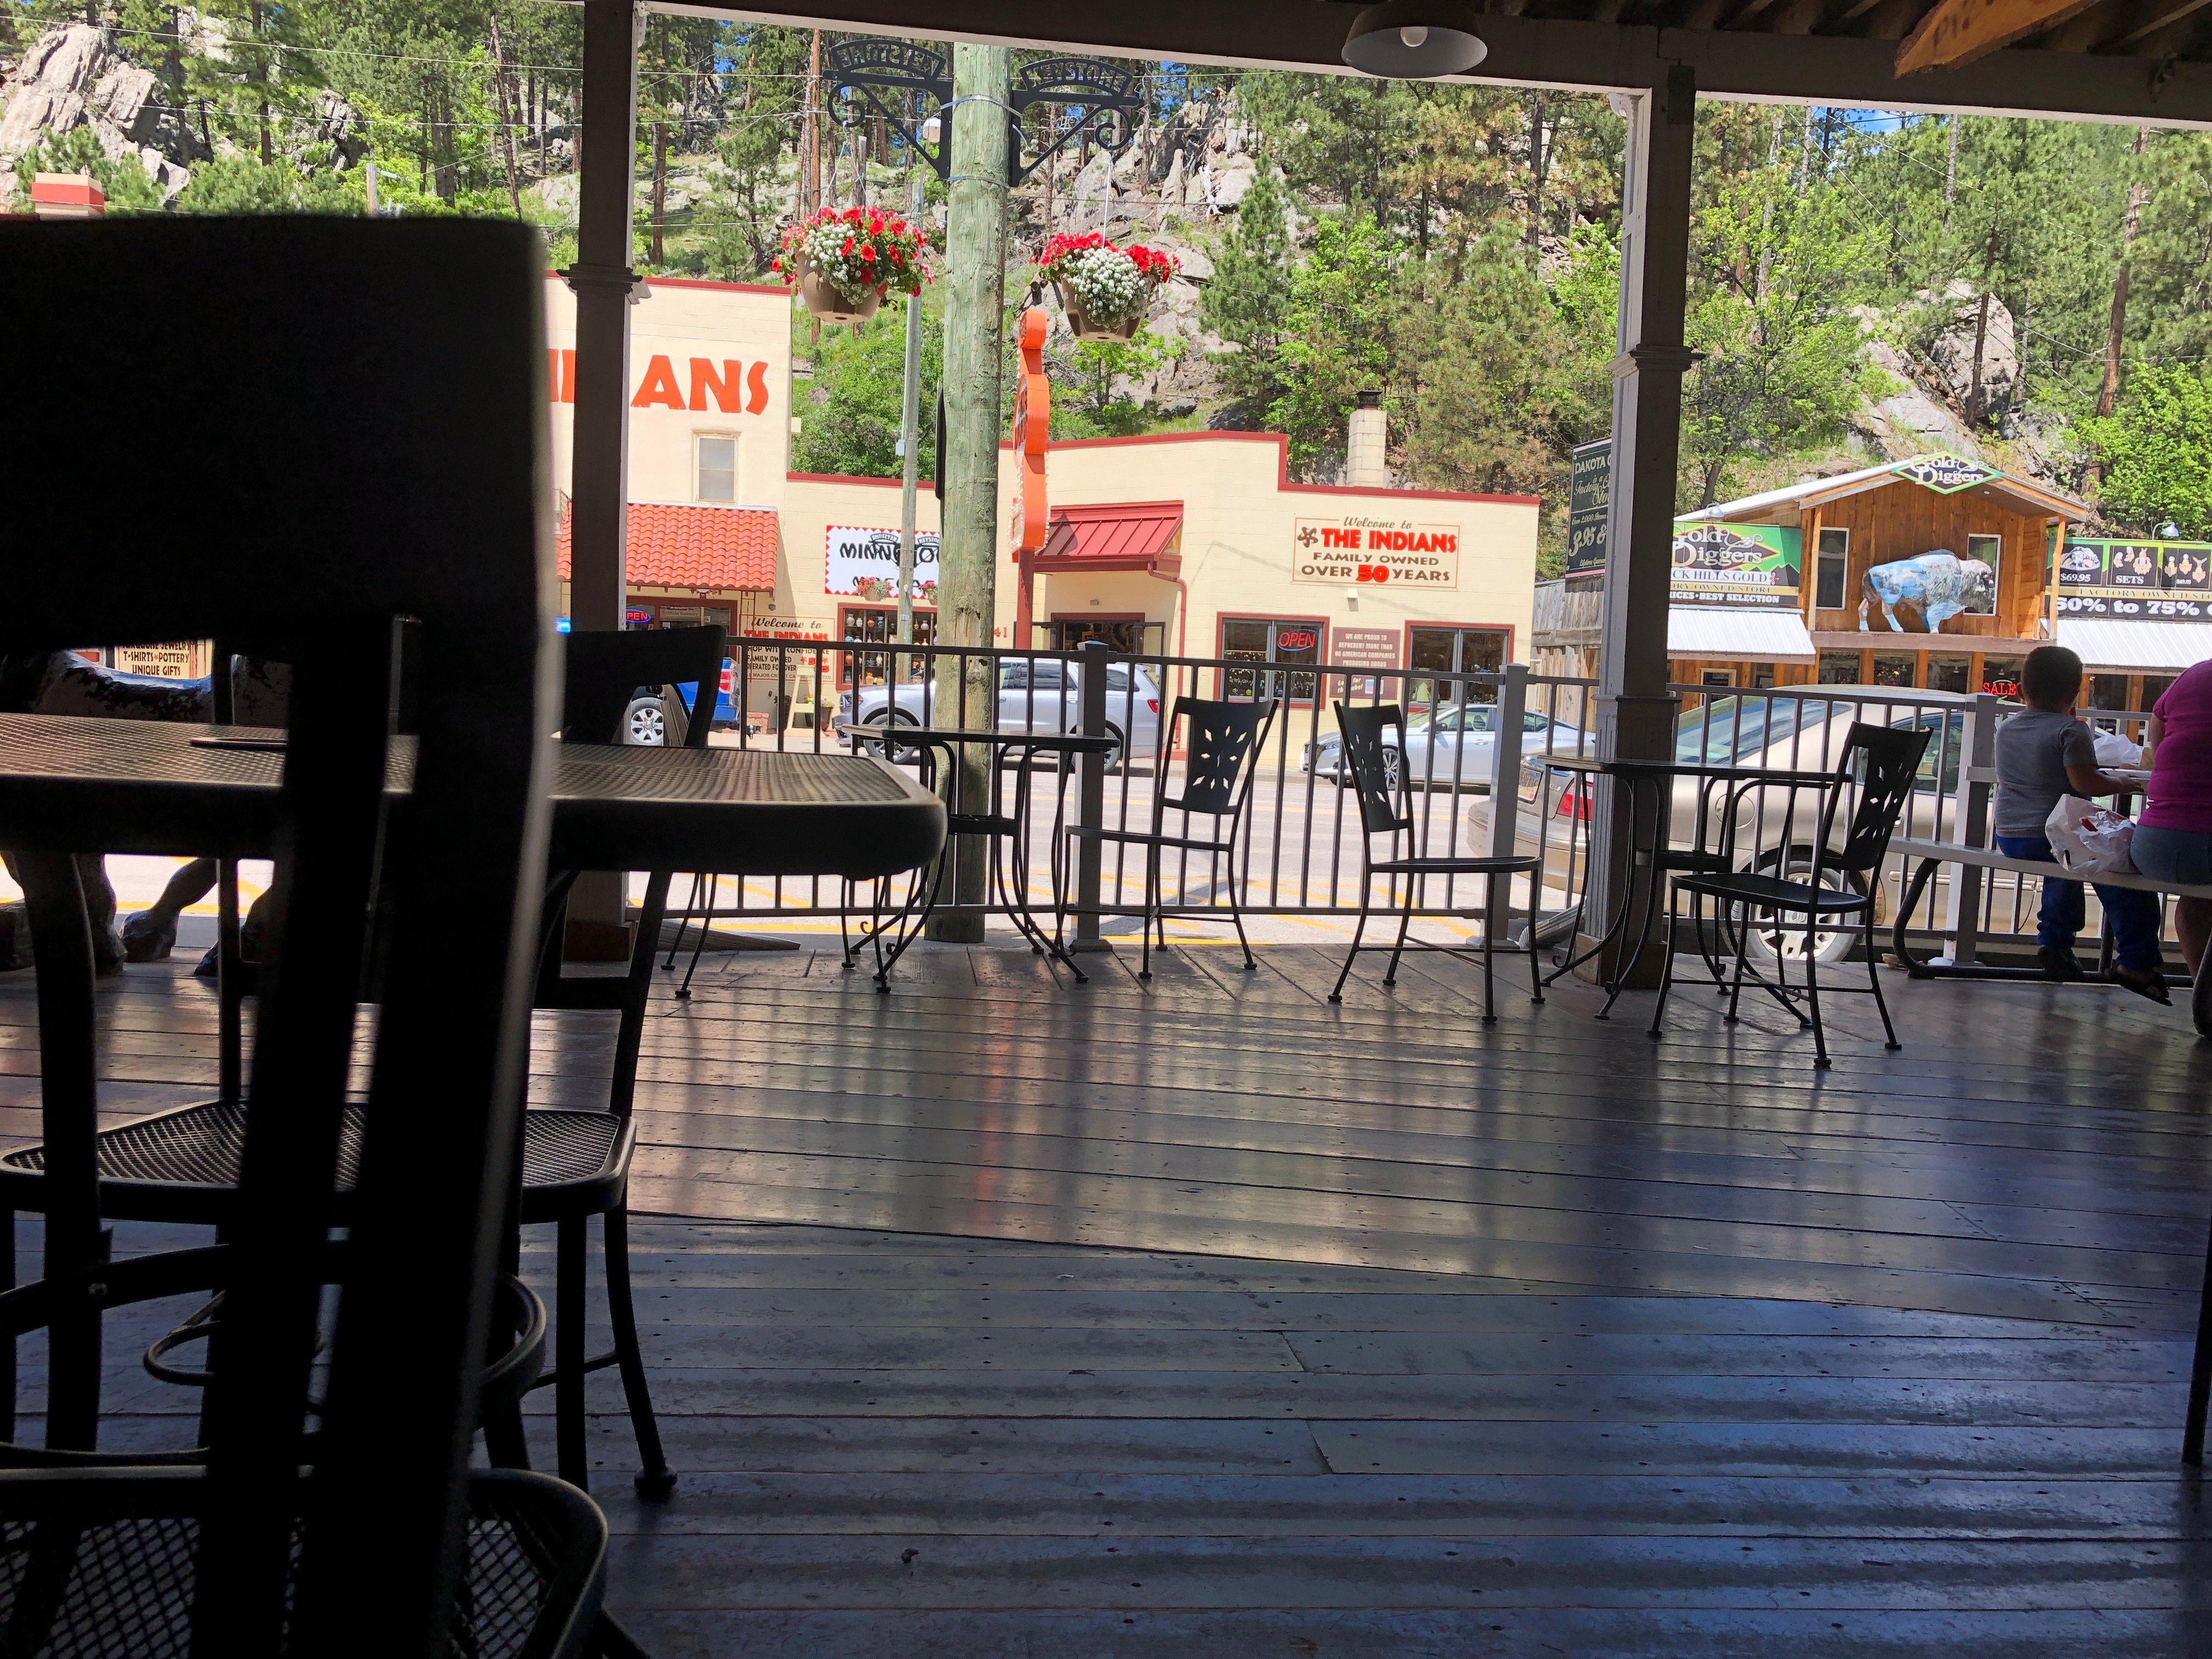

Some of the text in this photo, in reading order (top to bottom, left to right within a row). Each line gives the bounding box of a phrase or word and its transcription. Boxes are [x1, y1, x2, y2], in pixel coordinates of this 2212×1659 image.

[1026, 62, 1127, 92] KEYSTONE
[1575, 456, 1606, 475] DAKOTA
[1910, 454, 1959, 472] Gold
[1915, 465, 1984, 484] Diggers
[1592, 486, 1610, 505] Sto
[1344, 516, 1413, 529] Welcome to
[1321, 528, 1458, 554] THE INDIANS
[1313, 552, 1440, 566] FAMILY OWNED
[1672, 540, 1763, 567] Diggers
[1301, 564, 1450, 583] OVER 50 YEARS
[1694, 571, 1729, 581] HILLS
[1733, 572, 1767, 582] GOLD
[2061, 573, 2091, 583] $69.95
[2115, 575, 2144, 584] SETS
[1726, 593, 1780, 603] SELECTION
[2079, 588, 2136, 597] FACTORY
[2057, 597, 2106, 613] 50%
[2113, 600, 2140, 613] to
[2147, 600, 2200, 616] 75%
[627, 612, 648, 620] PEN
[752, 617, 823, 629] Welcome to
[774, 631, 830, 641] INDIANS
[1278, 631, 1316, 647] OPEN
[123, 651, 189, 663] T-SHIRTS POTTERY
[132, 664, 180, 676] UNIQUE GIFTS
[1983, 682, 2016, 696] SALE
